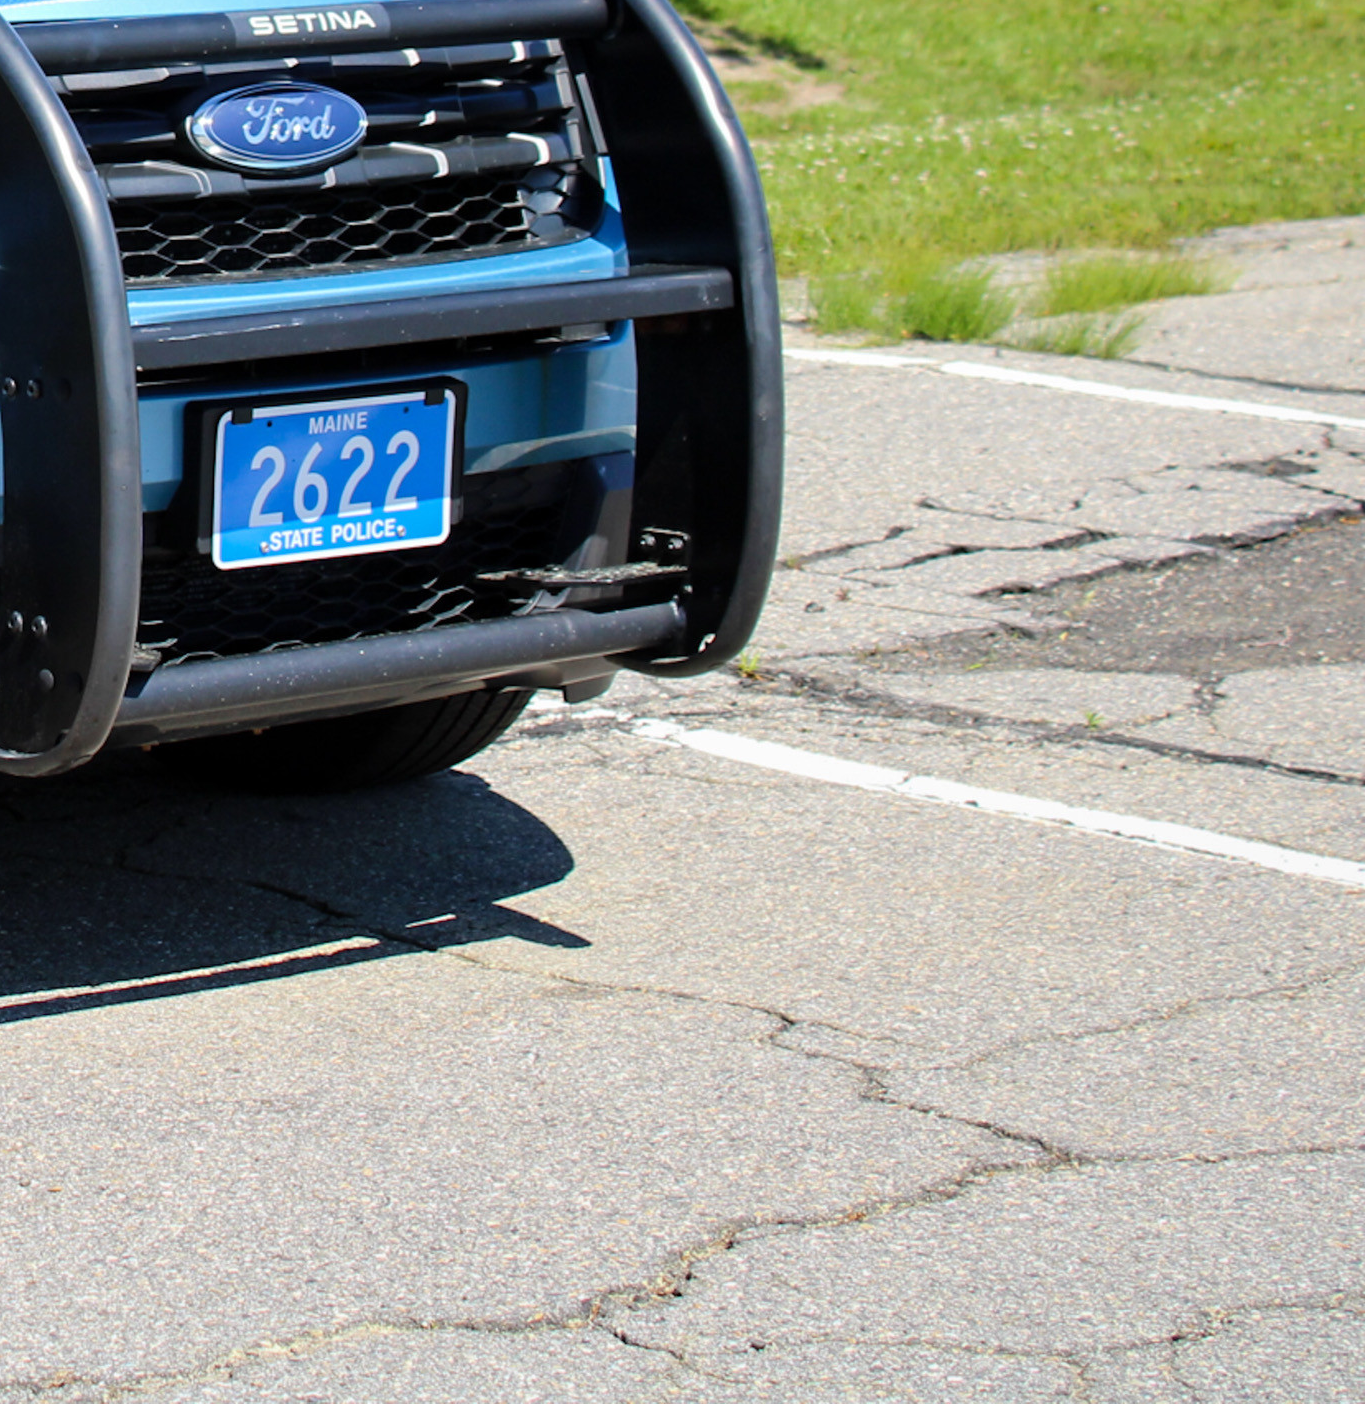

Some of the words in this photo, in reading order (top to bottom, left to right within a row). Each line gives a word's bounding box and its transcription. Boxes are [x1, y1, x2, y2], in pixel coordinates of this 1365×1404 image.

[248, 9, 376, 37] SETINA
[242, 94, 338, 145] Ford
[308, 411, 369, 436] MAINE
[248, 429, 420, 528] 2622
[270, 527, 324, 552] STATE
[331, 518, 397, 544] POLICE
